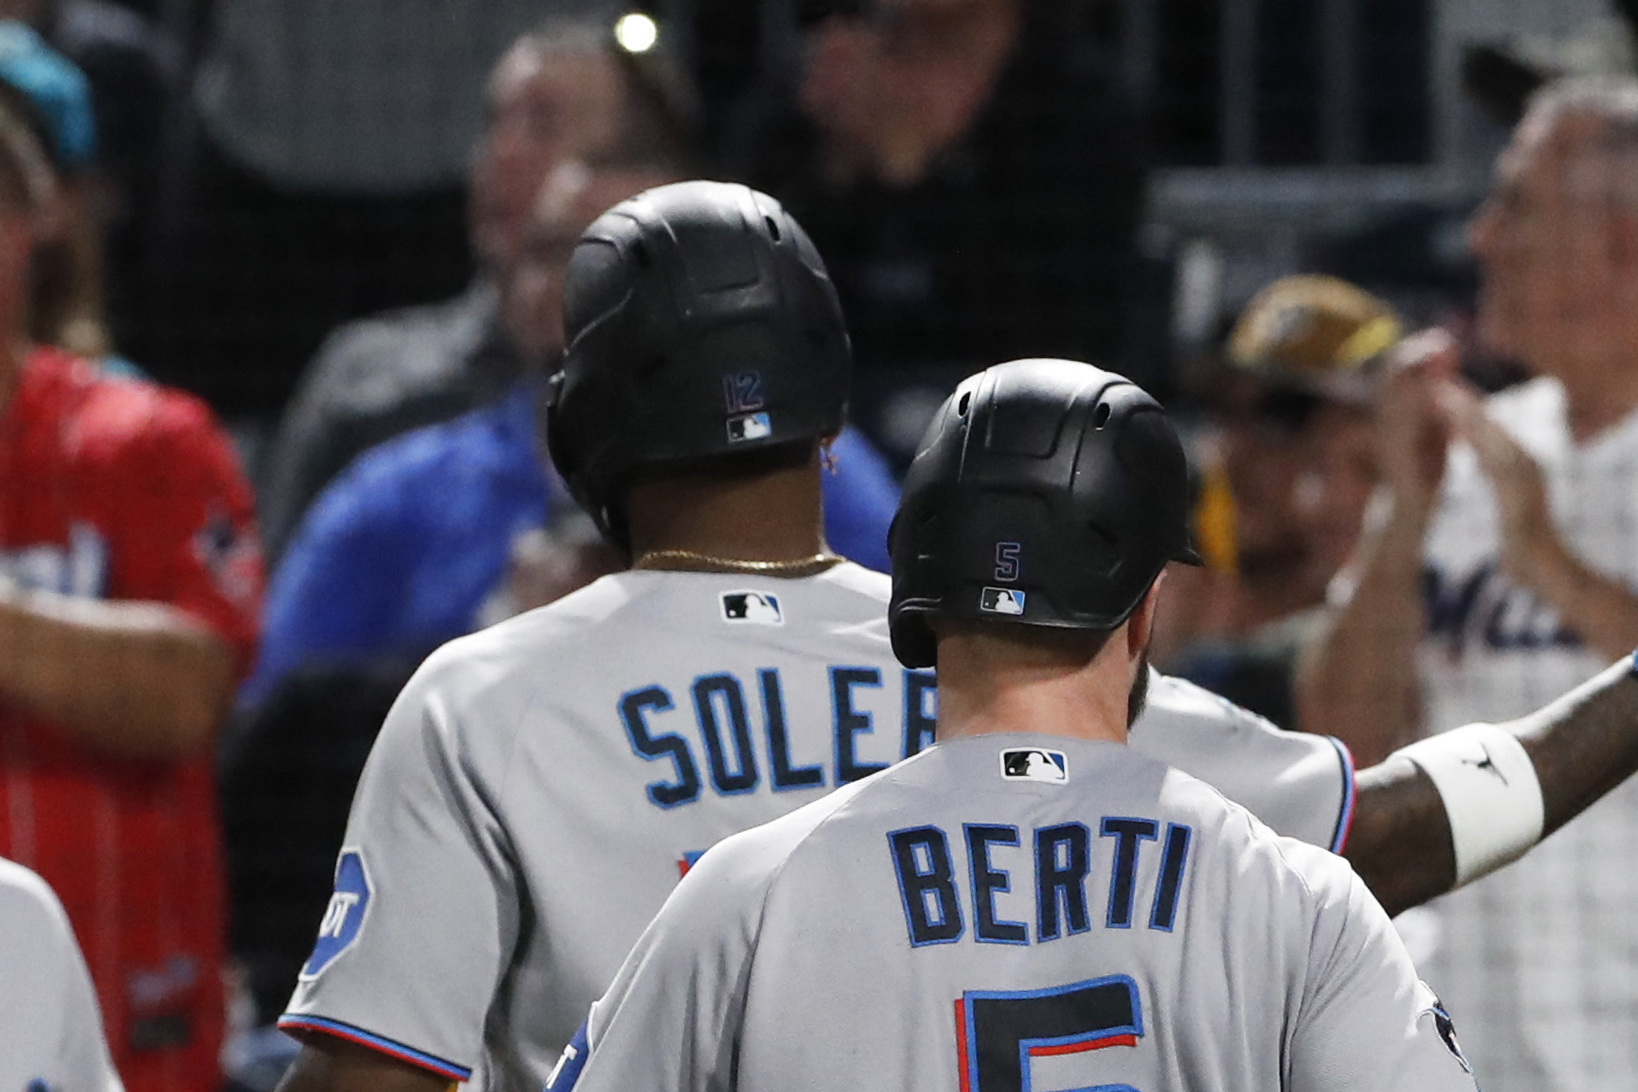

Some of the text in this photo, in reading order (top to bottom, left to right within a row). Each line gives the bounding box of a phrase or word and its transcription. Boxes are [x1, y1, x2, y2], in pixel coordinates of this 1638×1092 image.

[722, 369, 765, 413] 12
[994, 541, 1021, 581] 5
[886, 816, 1192, 948] BERTI
[319, 890, 360, 938] DT
